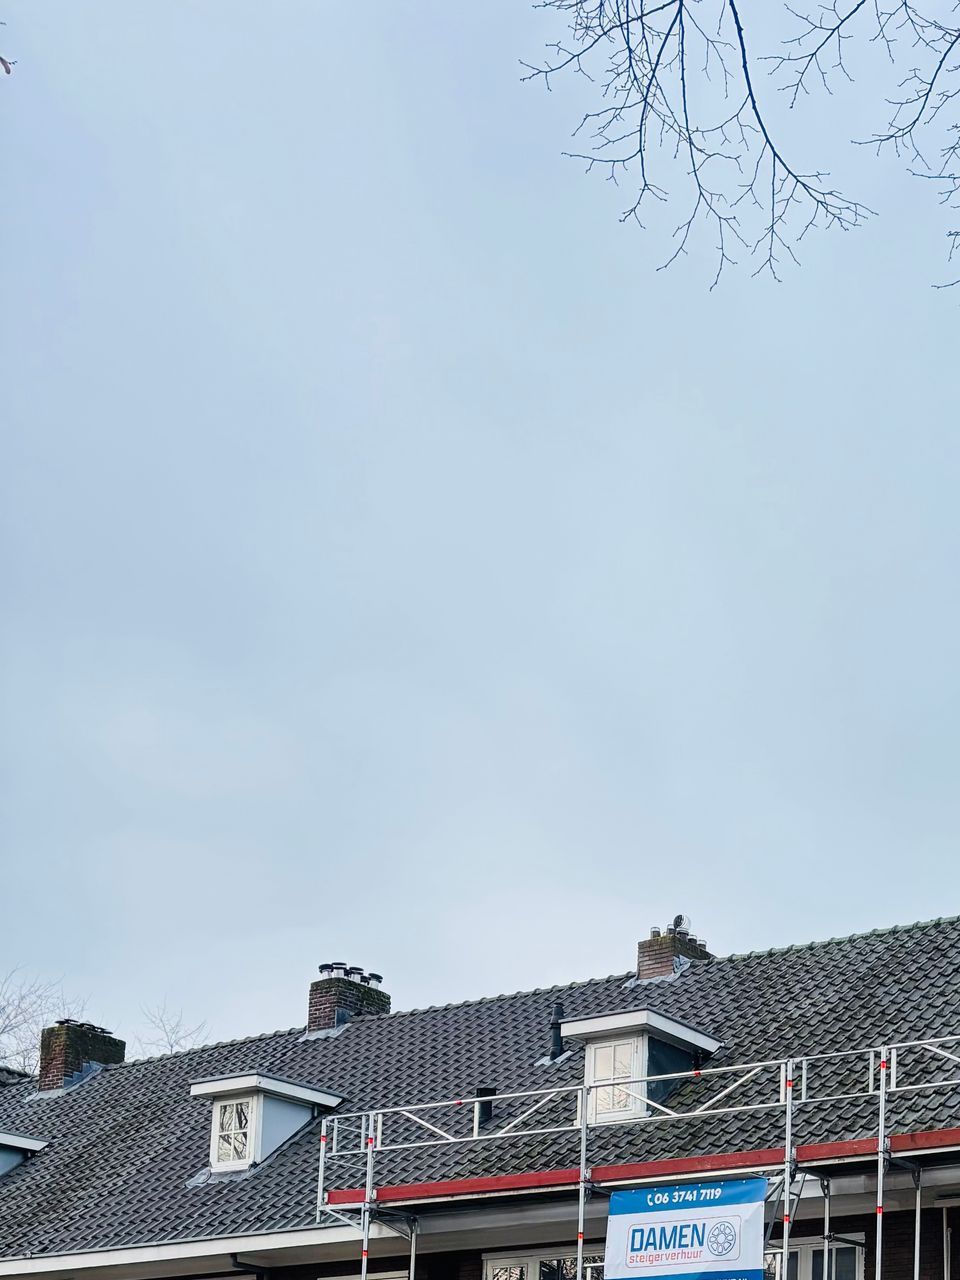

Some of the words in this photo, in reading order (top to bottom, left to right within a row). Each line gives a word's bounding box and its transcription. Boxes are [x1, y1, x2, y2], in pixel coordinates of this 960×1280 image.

[654, 1192, 669, 1204] 06
[672, 1190, 697, 1203] 3741
[700, 1188, 722, 1201] 7119
[630, 1222, 706, 1252] DAMEN
[629, 1250, 703, 1265] steigerverhuur
